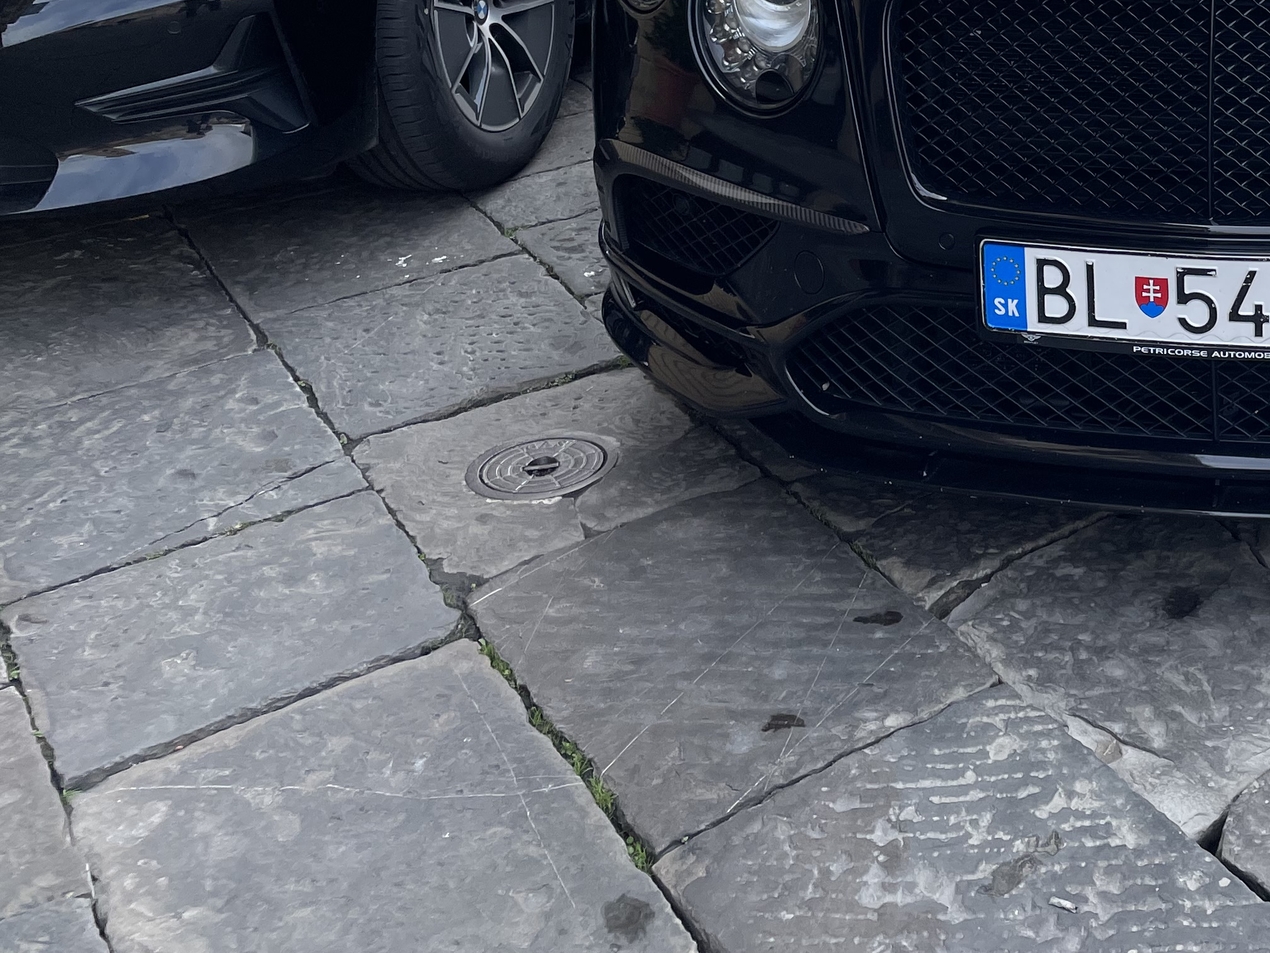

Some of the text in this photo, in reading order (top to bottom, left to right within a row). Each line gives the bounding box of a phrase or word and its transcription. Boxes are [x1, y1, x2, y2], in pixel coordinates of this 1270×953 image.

[1035, 256, 1127, 330] BL
[993, 297, 1020, 317] SK
[1133, 345, 1208, 357] PETRICORSE
